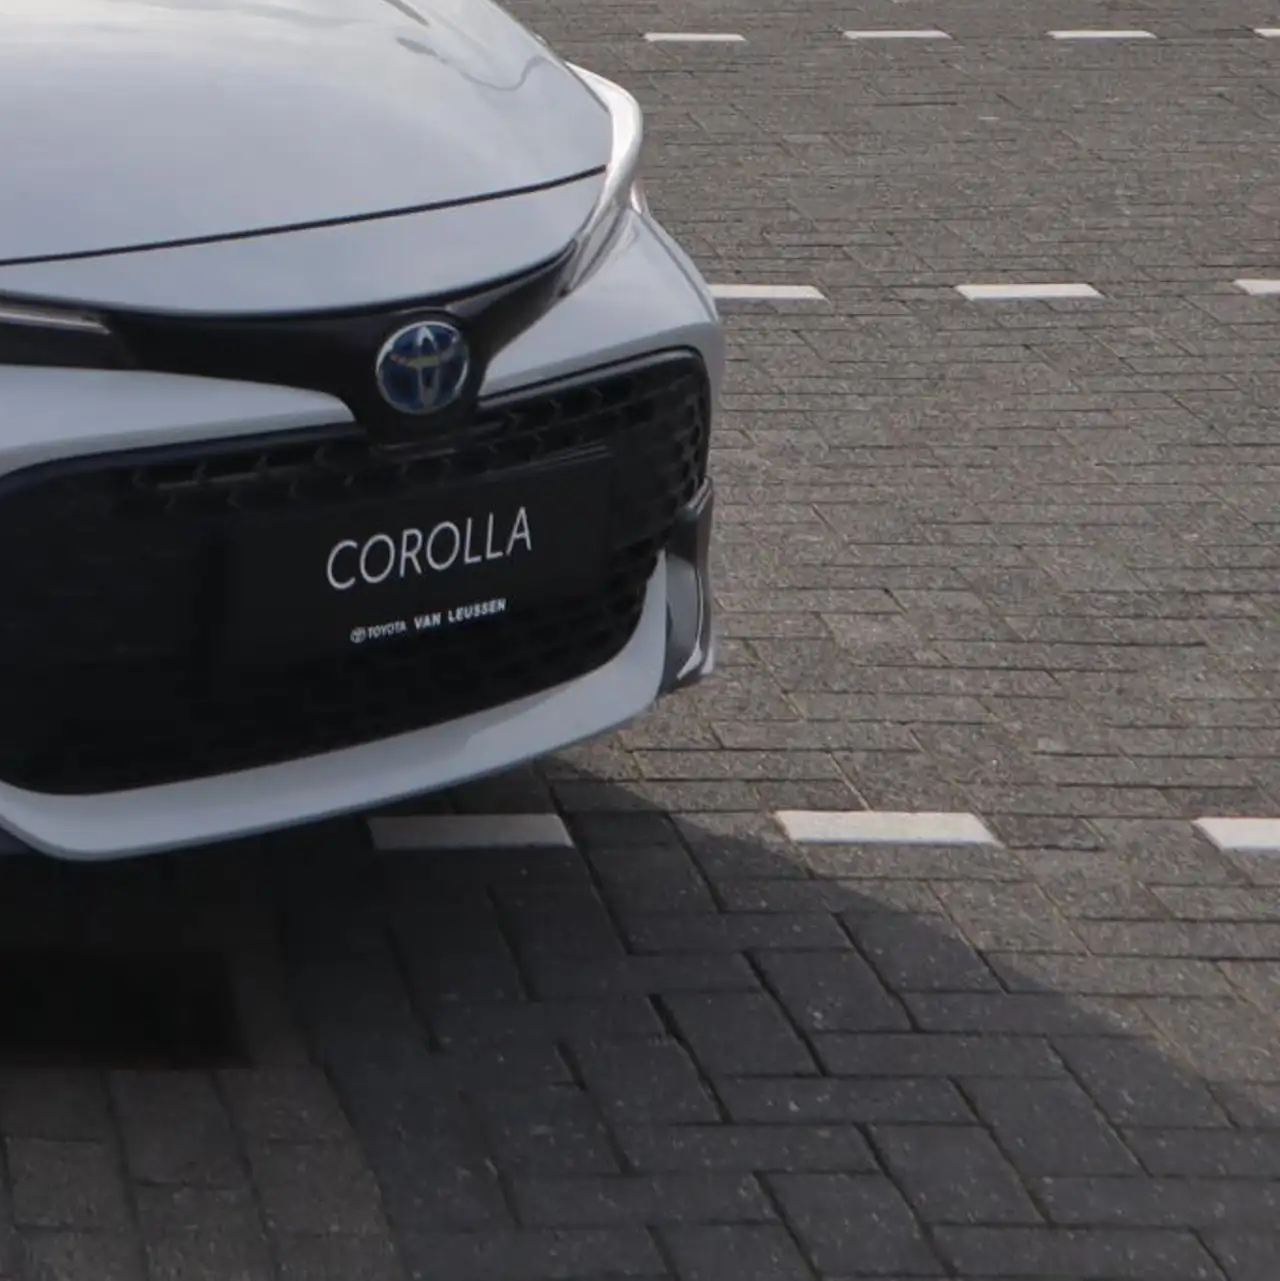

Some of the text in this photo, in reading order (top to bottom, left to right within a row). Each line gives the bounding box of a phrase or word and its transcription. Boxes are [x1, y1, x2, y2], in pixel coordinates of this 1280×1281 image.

[326, 506, 532, 590] COROLLA
[367, 598, 507, 639] TOYOTA VAN LEUSSEN
